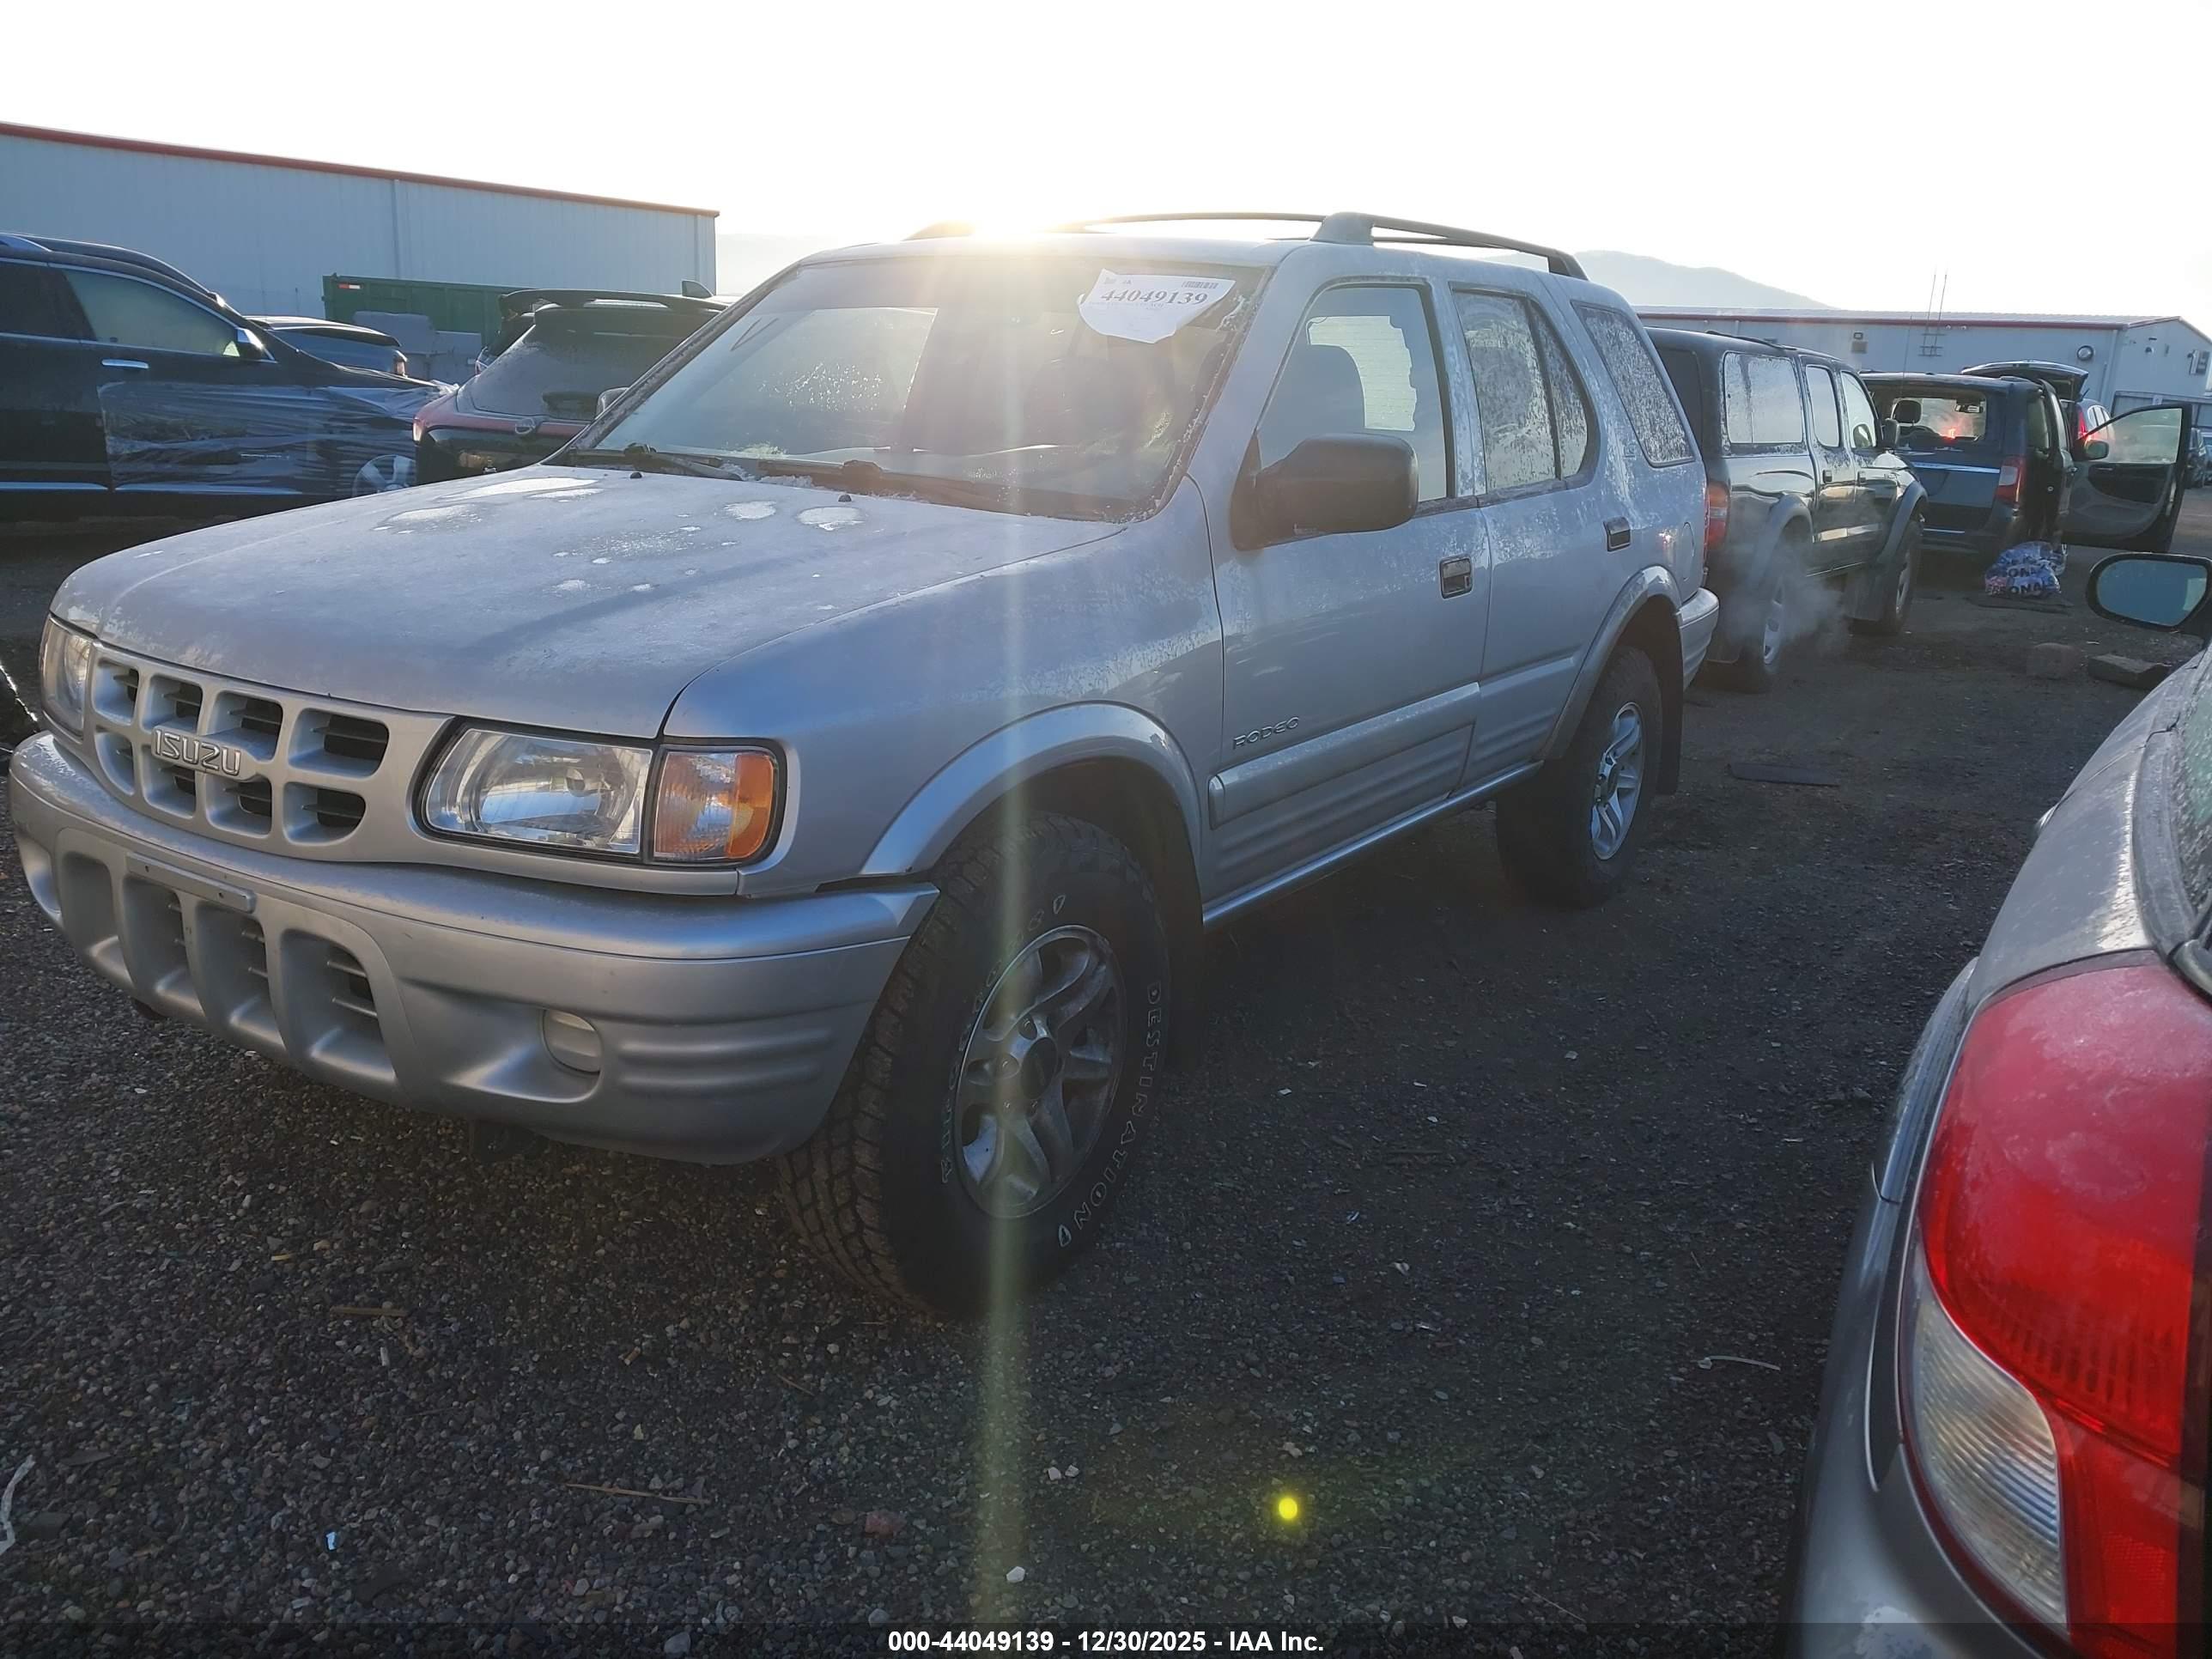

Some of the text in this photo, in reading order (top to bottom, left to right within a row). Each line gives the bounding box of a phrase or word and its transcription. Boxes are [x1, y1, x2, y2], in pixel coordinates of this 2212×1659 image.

[1101, 289, 1208, 305] 44049139
[155, 729, 241, 776] ISUZU
[1232, 715, 1299, 750] RODEO
[1073, 981, 1162, 1230] DESTINATION
